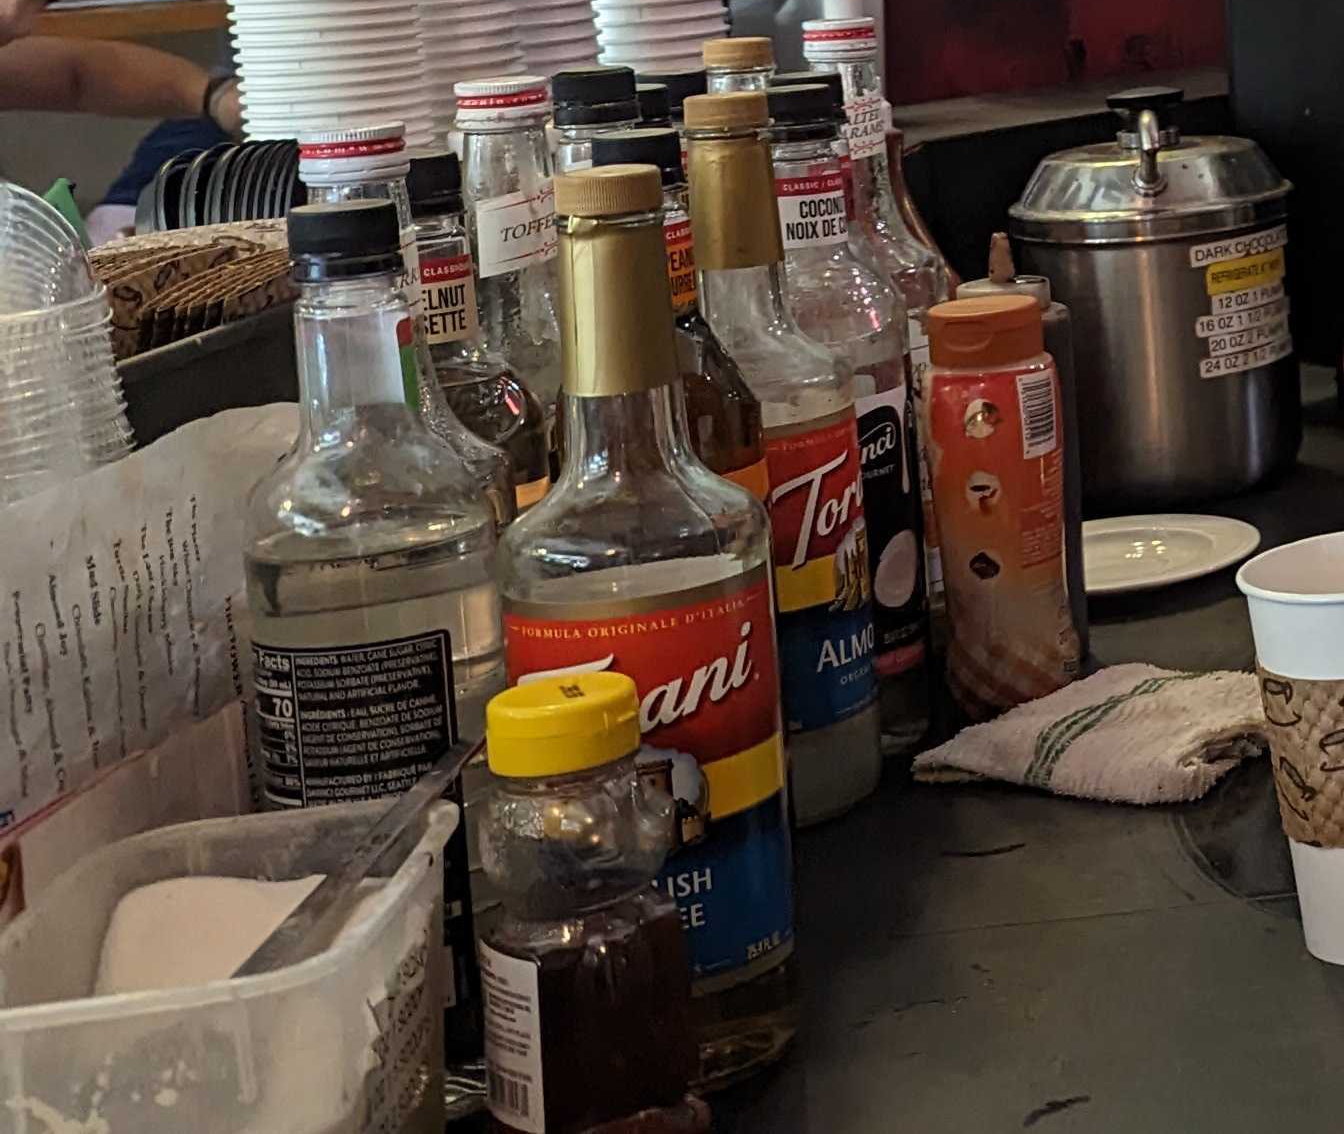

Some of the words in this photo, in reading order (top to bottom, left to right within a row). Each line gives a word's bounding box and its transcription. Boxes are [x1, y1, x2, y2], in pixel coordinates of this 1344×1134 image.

[799, 195, 844, 218] COCON
[786, 221, 820, 241] NOIX
[822, 219, 836, 237] DE
[1194, 245, 1232, 262] DARK
[1217, 296, 1232, 310] 12
[1235, 292, 1249, 307] OZ
[1199, 319, 1215, 332] 16
[1218, 316, 1234, 330] OZ
[1211, 339, 1226, 353] 20
[1229, 334, 1244, 348] OZ
[1205, 359, 1221, 374] 24
[1224, 355, 1239, 370] OZ
[860, 426, 896, 465] nci
[770, 449, 865, 572] Tor
[522, 625, 582, 640] FORMULA
[587, 617, 677, 639] ORIGINALE
[272, 697, 293, 717] 70
[650, 867, 713, 898] ISH
